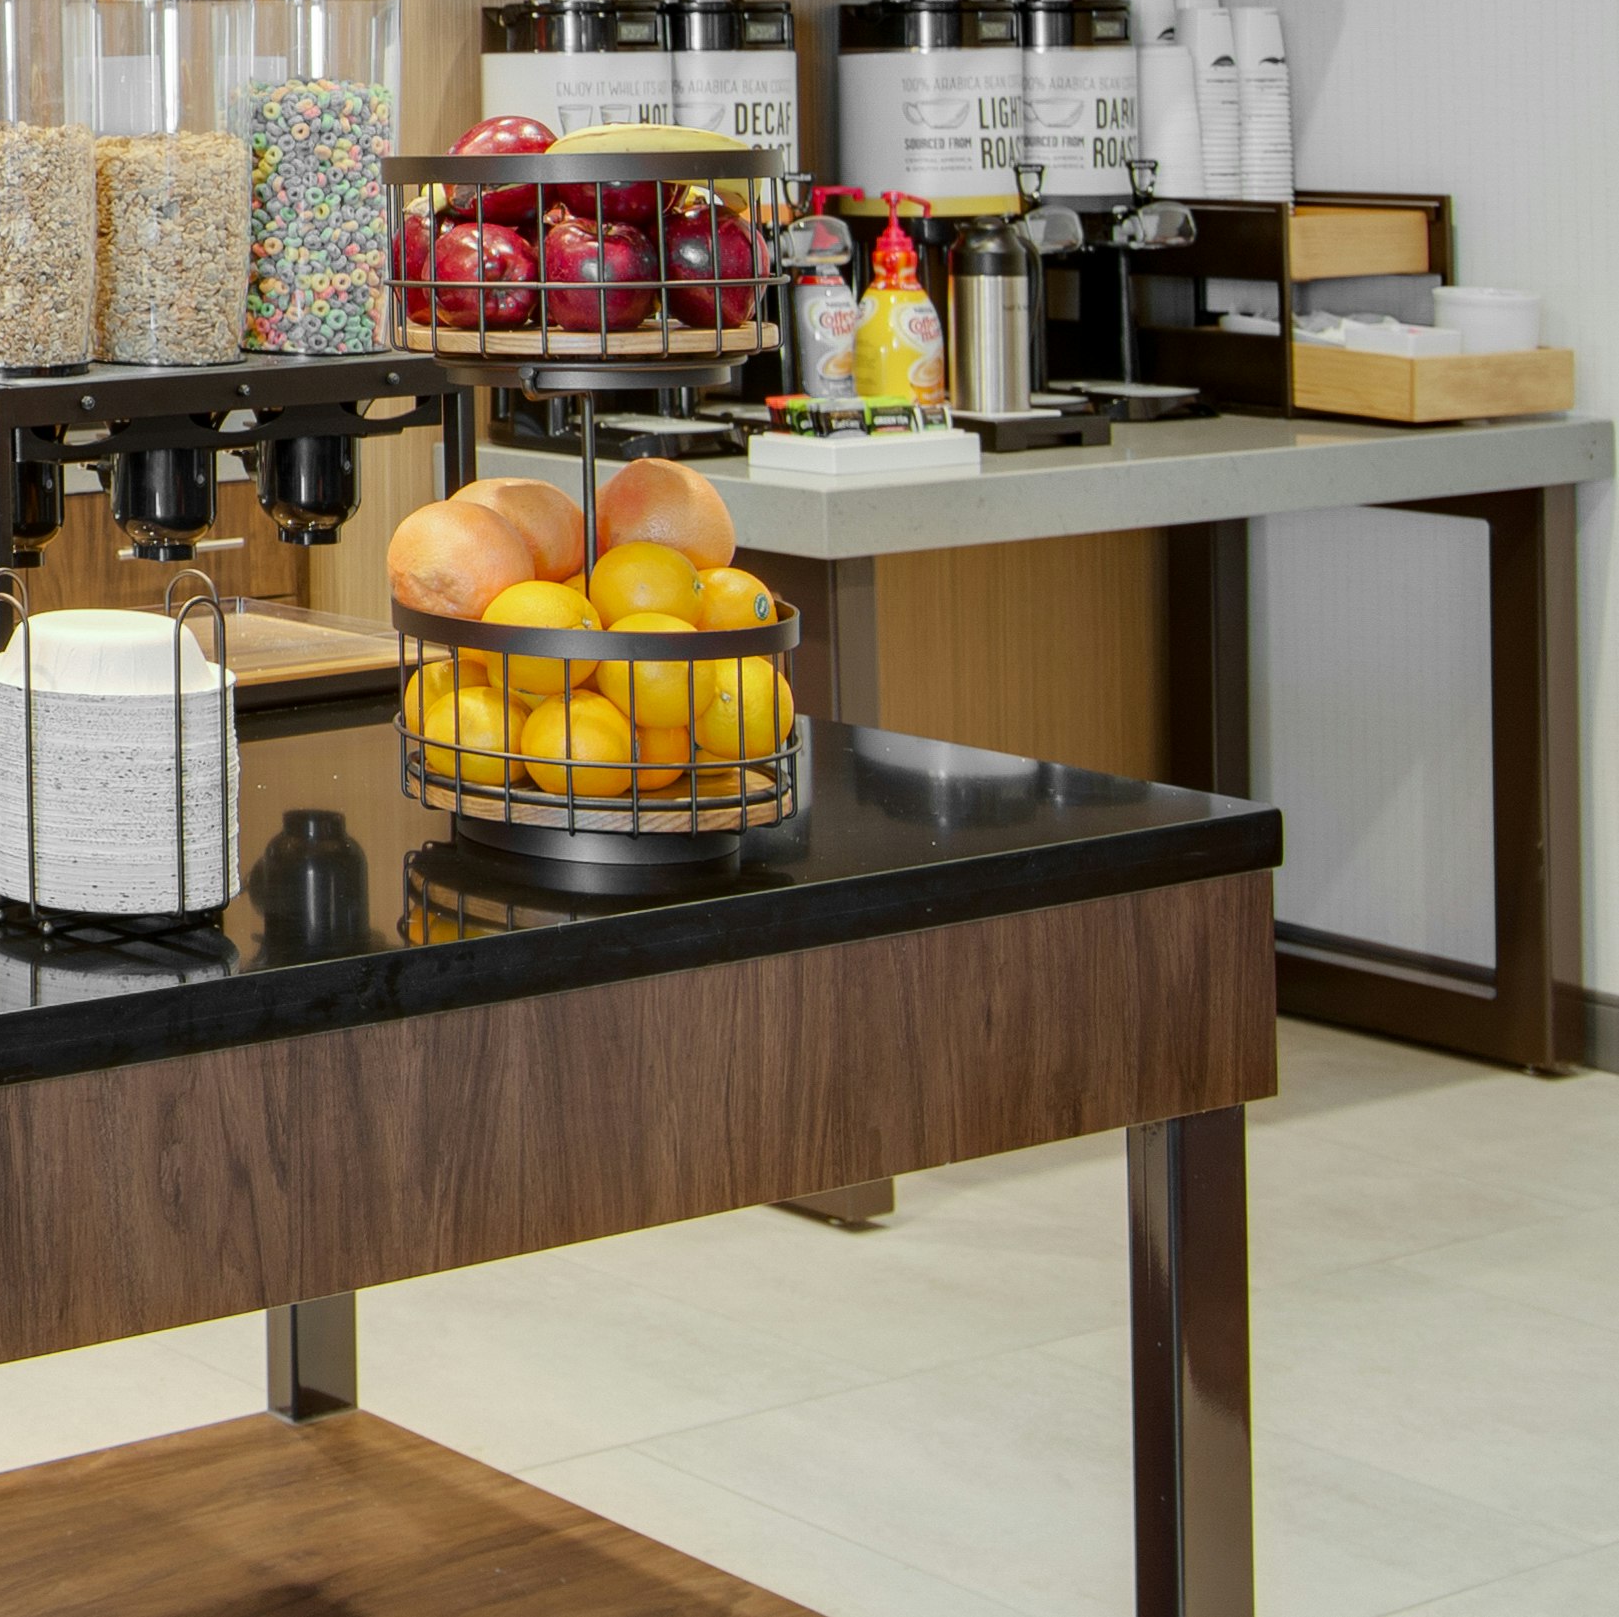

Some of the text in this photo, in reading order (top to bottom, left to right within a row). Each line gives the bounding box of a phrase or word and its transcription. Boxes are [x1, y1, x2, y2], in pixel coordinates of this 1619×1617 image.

[556, 81, 591, 97] ENJOY
[734, 101, 792, 136] DECAF
[904, 137, 972, 150] SOURCED FROM
